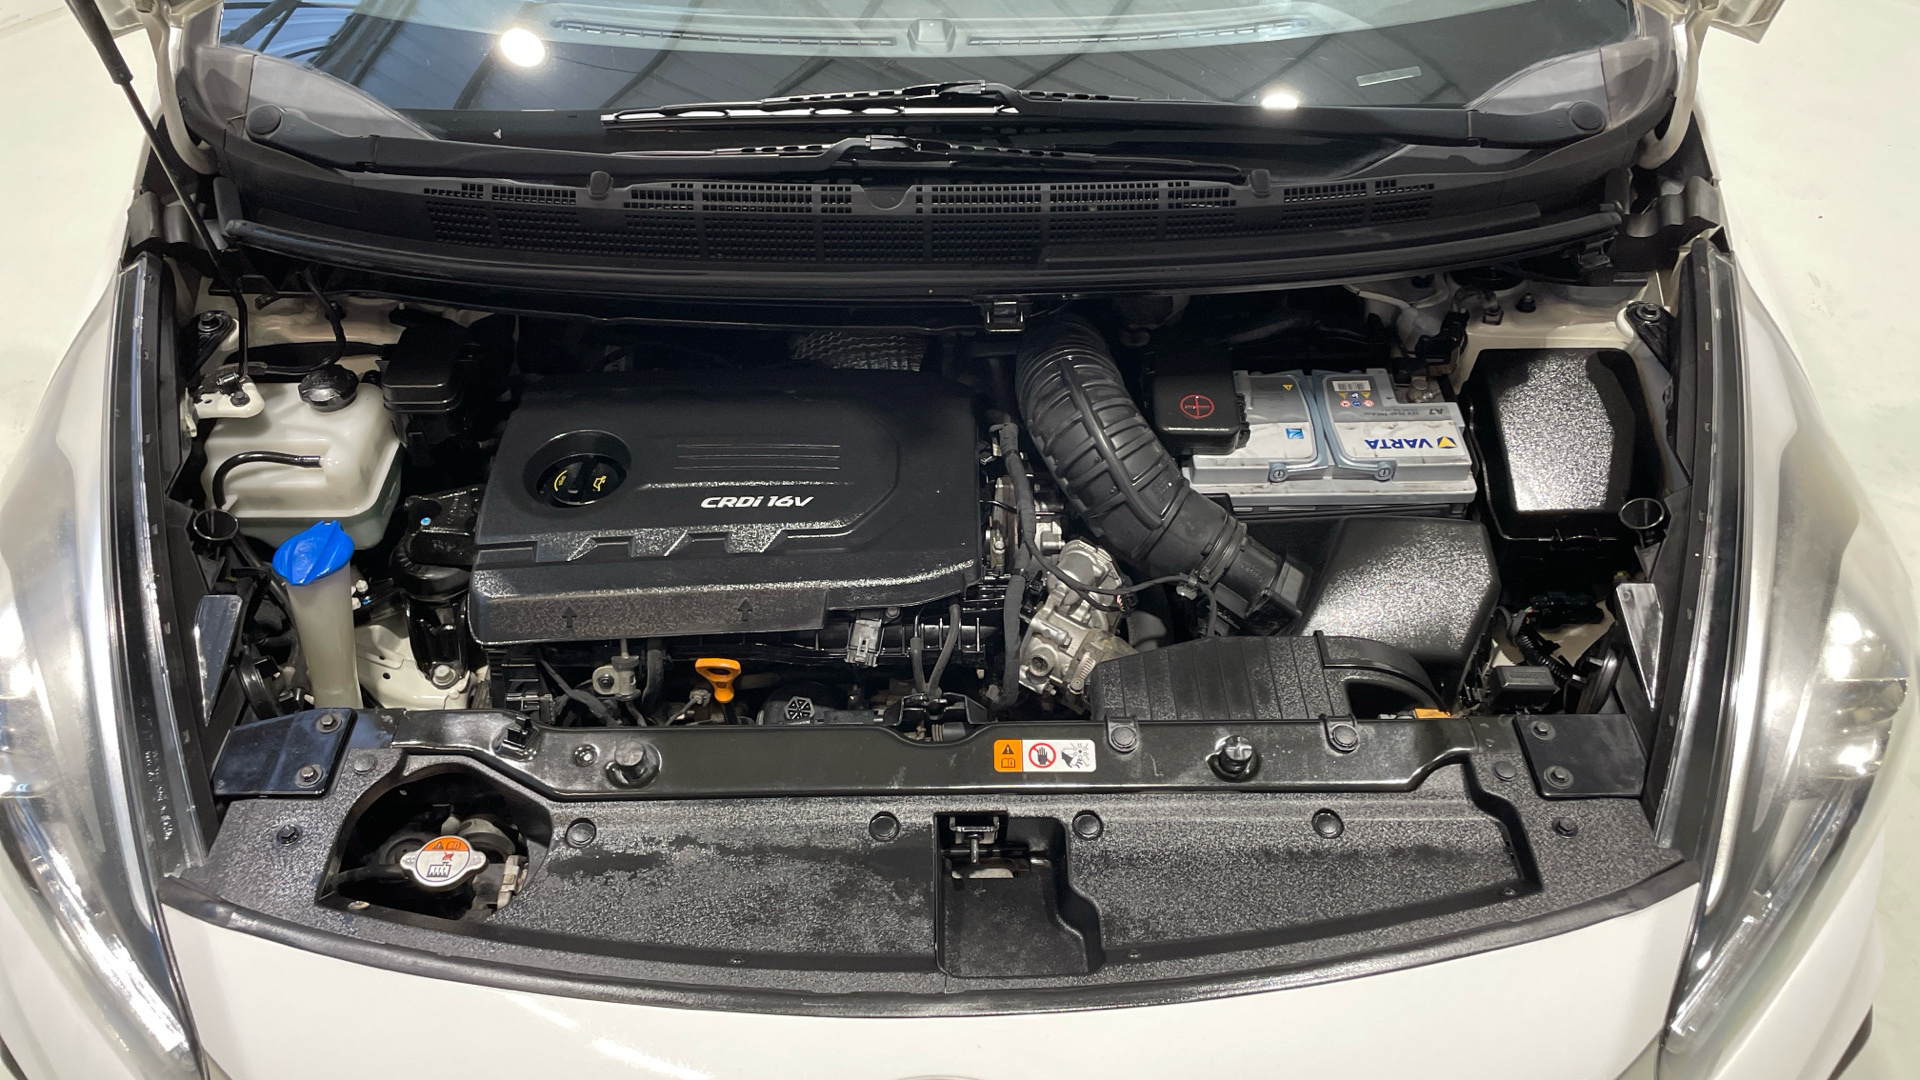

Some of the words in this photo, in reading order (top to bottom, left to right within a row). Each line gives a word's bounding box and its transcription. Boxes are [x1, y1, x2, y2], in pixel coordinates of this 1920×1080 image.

[1364, 438, 1433, 450] VARTA
[700, 496, 764, 508] CRDi
[767, 496, 814, 507] 16V
